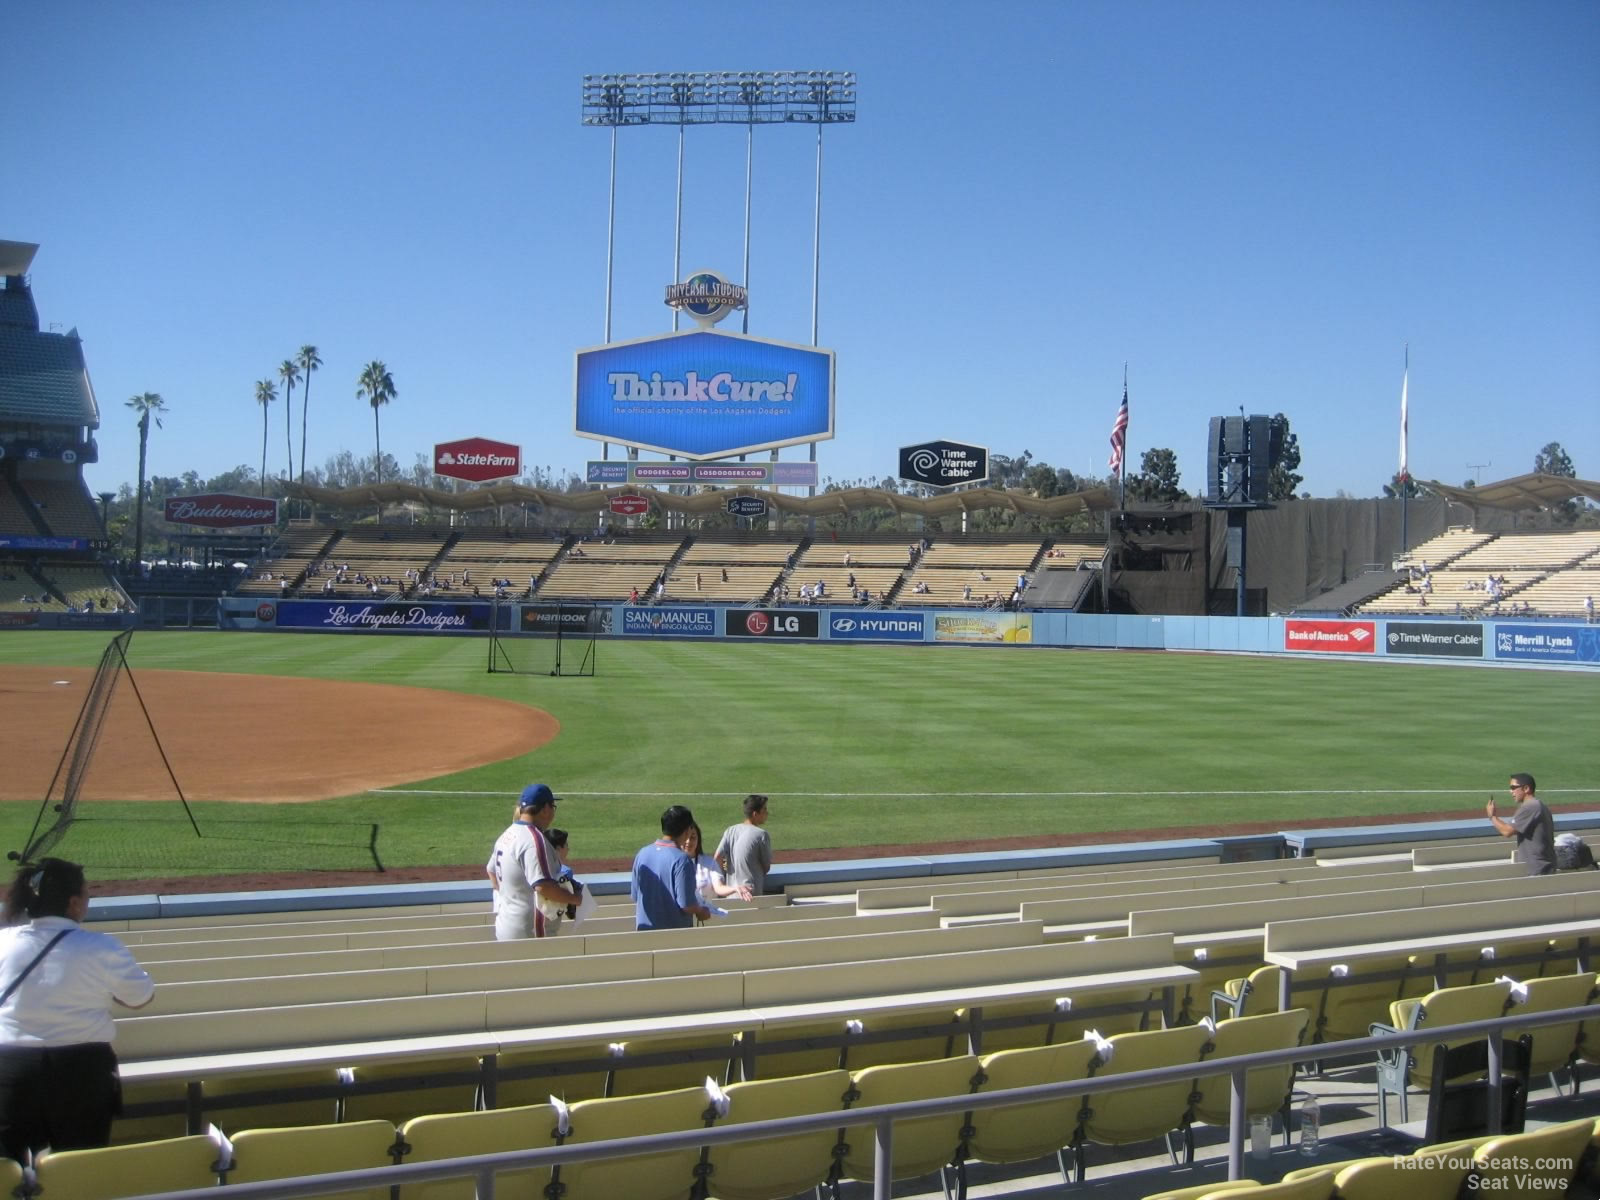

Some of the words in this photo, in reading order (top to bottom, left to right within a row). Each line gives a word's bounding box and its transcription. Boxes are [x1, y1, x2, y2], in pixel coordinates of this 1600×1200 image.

[665, 283, 709, 299] UNIVERSAL
[712, 282, 744, 299] STUDIOS
[608, 372, 798, 402] ThinkCure!
[657, 407, 683, 415] charity
[726, 407, 756, 415] Angeles
[758, 407, 791, 415] Dodgers
[941, 449, 966, 458] Time
[941, 459, 978, 467] Warner
[941, 468, 970, 477] Cable
[169, 501, 274, 519] Budweiser
[323, 605, 352, 625] Los
[350, 606, 405, 629] Angeles
[405, 607, 465, 630] Dodgers
[625, 611, 651, 622] SAN
[661, 612, 712, 624] MANUEL
[774, 616, 799, 632] LG
[861, 621, 921, 632] HYUNDAI
[1289, 630, 1308, 640] Bank
[1308, 630, 1317, 640] of
[1317, 631, 1349, 641] America
[1399, 633, 1420, 643] Time
[1421, 634, 1453, 644] Warner
[1454, 634, 1478, 645] Cable
[1514, 634, 1544, 645] Merrill
[1546, 635, 1573, 647] Lynch
